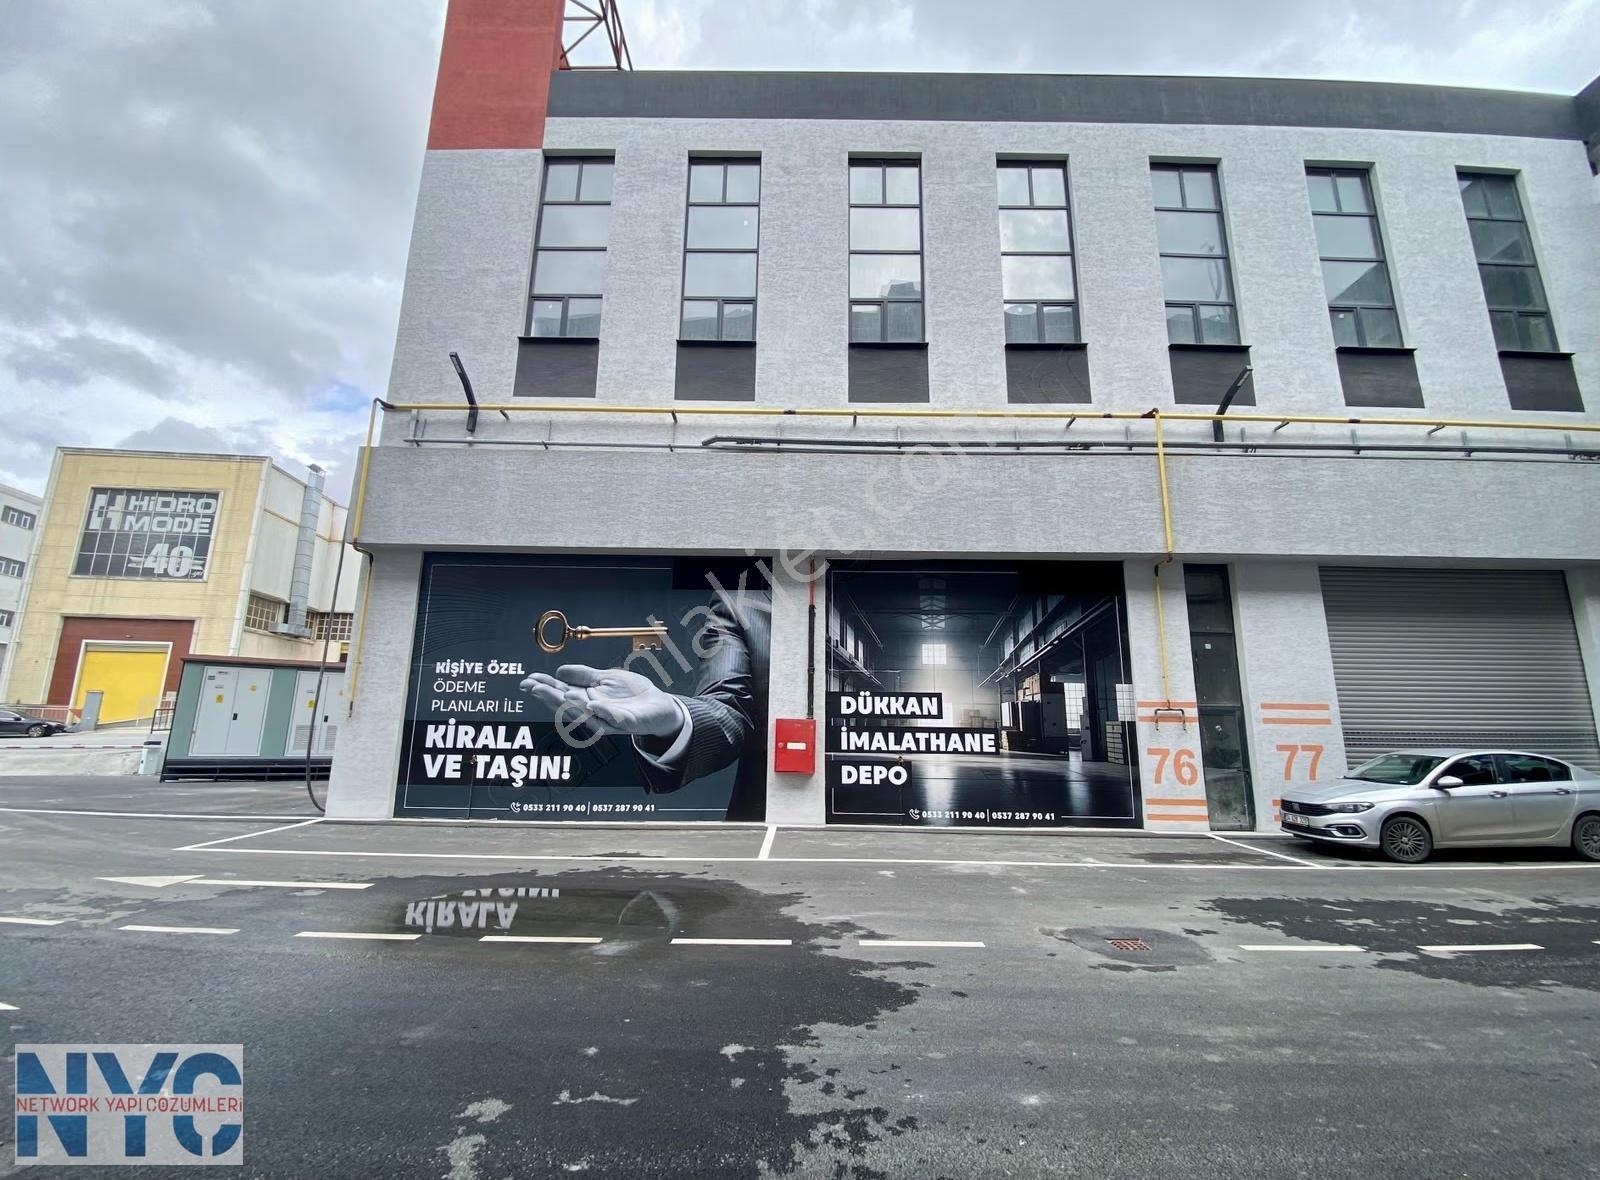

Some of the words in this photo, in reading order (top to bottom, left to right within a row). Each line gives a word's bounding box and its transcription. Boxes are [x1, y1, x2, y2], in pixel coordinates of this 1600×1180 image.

[124, 514, 211, 533] MODE
[144, 543, 193, 578] 40
[435, 658, 483, 677] KİŞİYE
[487, 659, 525, 675] ÖZEL
[433, 678, 486, 693] ÖDEME
[431, 699, 499, 713] PLANLARI
[503, 698, 524, 712] İLE
[840, 691, 938, 715] DÜKKAN
[425, 718, 534, 749] KİRALA
[840, 726, 996, 752] İMALATHANE
[423, 754, 463, 778] VE
[476, 754, 571, 787] TAŞIN!
[1146, 747, 1199, 786] 76
[1275, 744, 1324, 781] 77
[841, 765, 908, 785] DEPO
[522, 804, 543, 812] 0533
[545, 804, 560, 812] 211
[562, 804, 574, 812] 90
[575, 804, 586, 812] 40
[592, 804, 612, 812] 0537
[615, 804, 630, 812] 287
[632, 804, 644, 812] 90
[645, 804, 655, 812] 41
[922, 810, 942, 818] 0533
[944, 810, 960, 819] 211
[962, 811, 973, 819] 90
[974, 811, 985, 819] 40
[992, 812, 1012, 820] 0537
[1014, 812, 1030, 820] 287
[1032, 812, 1044, 820] 90
[1045, 812, 1055, 820] 41
